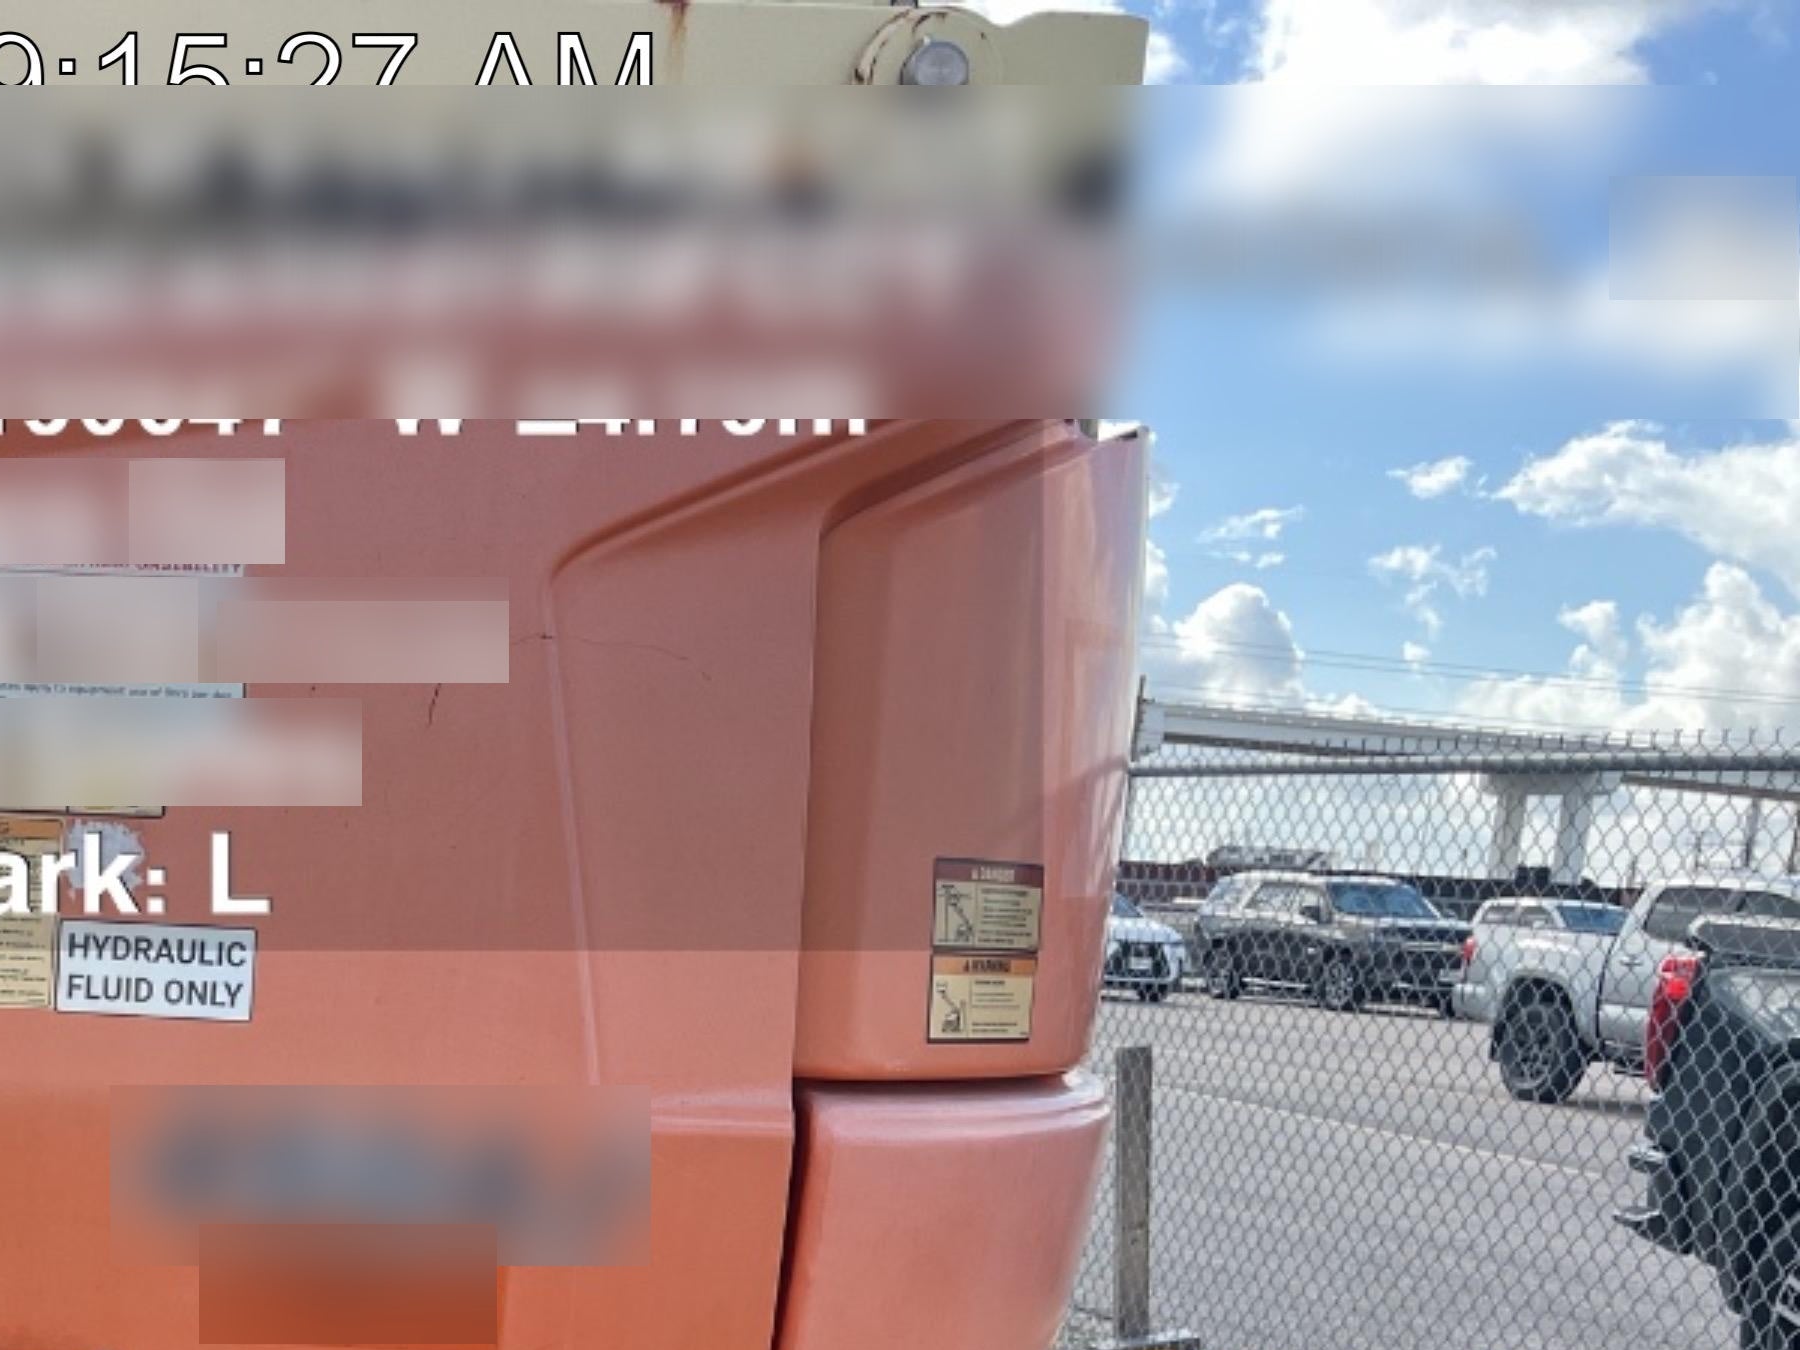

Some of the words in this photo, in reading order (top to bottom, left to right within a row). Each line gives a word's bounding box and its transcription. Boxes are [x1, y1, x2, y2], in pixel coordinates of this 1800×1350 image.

[67, 931, 248, 968] HYDRAULIC
[66, 973, 155, 1004] FLUID
[163, 978, 245, 1009] ONLY
